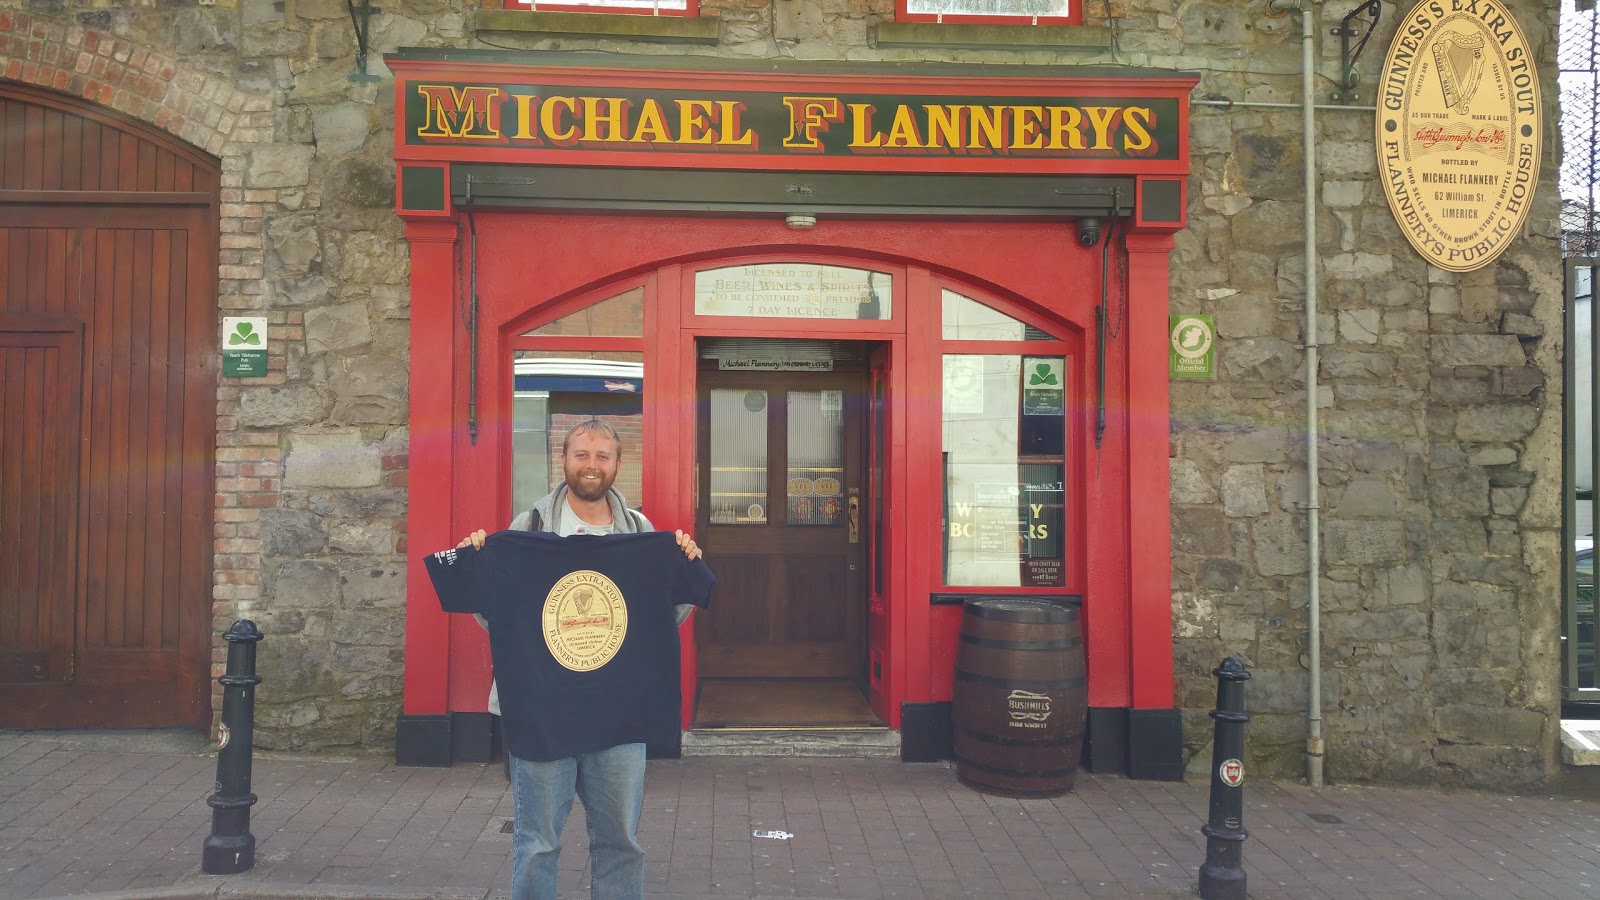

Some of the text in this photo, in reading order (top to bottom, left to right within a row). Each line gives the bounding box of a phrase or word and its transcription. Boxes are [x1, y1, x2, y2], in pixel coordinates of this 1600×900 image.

[1385, 0, 1535, 116] GUINNESS'S EXTRA STOUT
[417, 84, 1157, 154] MICHAEL FLANNERYS
[1385, 139, 1533, 262] FLANNERYS PUBLIC HOUSE
[1422, 172, 1499, 186] MICHAEL FLANNERY
[1434, 191, 1487, 203] 62 William St.
[1406, 166, 1512, 244] WHO SELLS NO OTHER BROWN STOUT IN BOTTLE
[1442, 208, 1479, 219] LIMERICK
[548, 577, 575, 615] GUINNESS
[576, 574, 605, 587] EXTRA
[603, 585, 622, 611] STOUT
[549, 629, 580, 666] FLANNERYS
[580, 650, 610, 667] PUBLIC
[609, 622, 623, 651] HOUSE
[1008, 699, 1050, 711] BUSHMILLS
